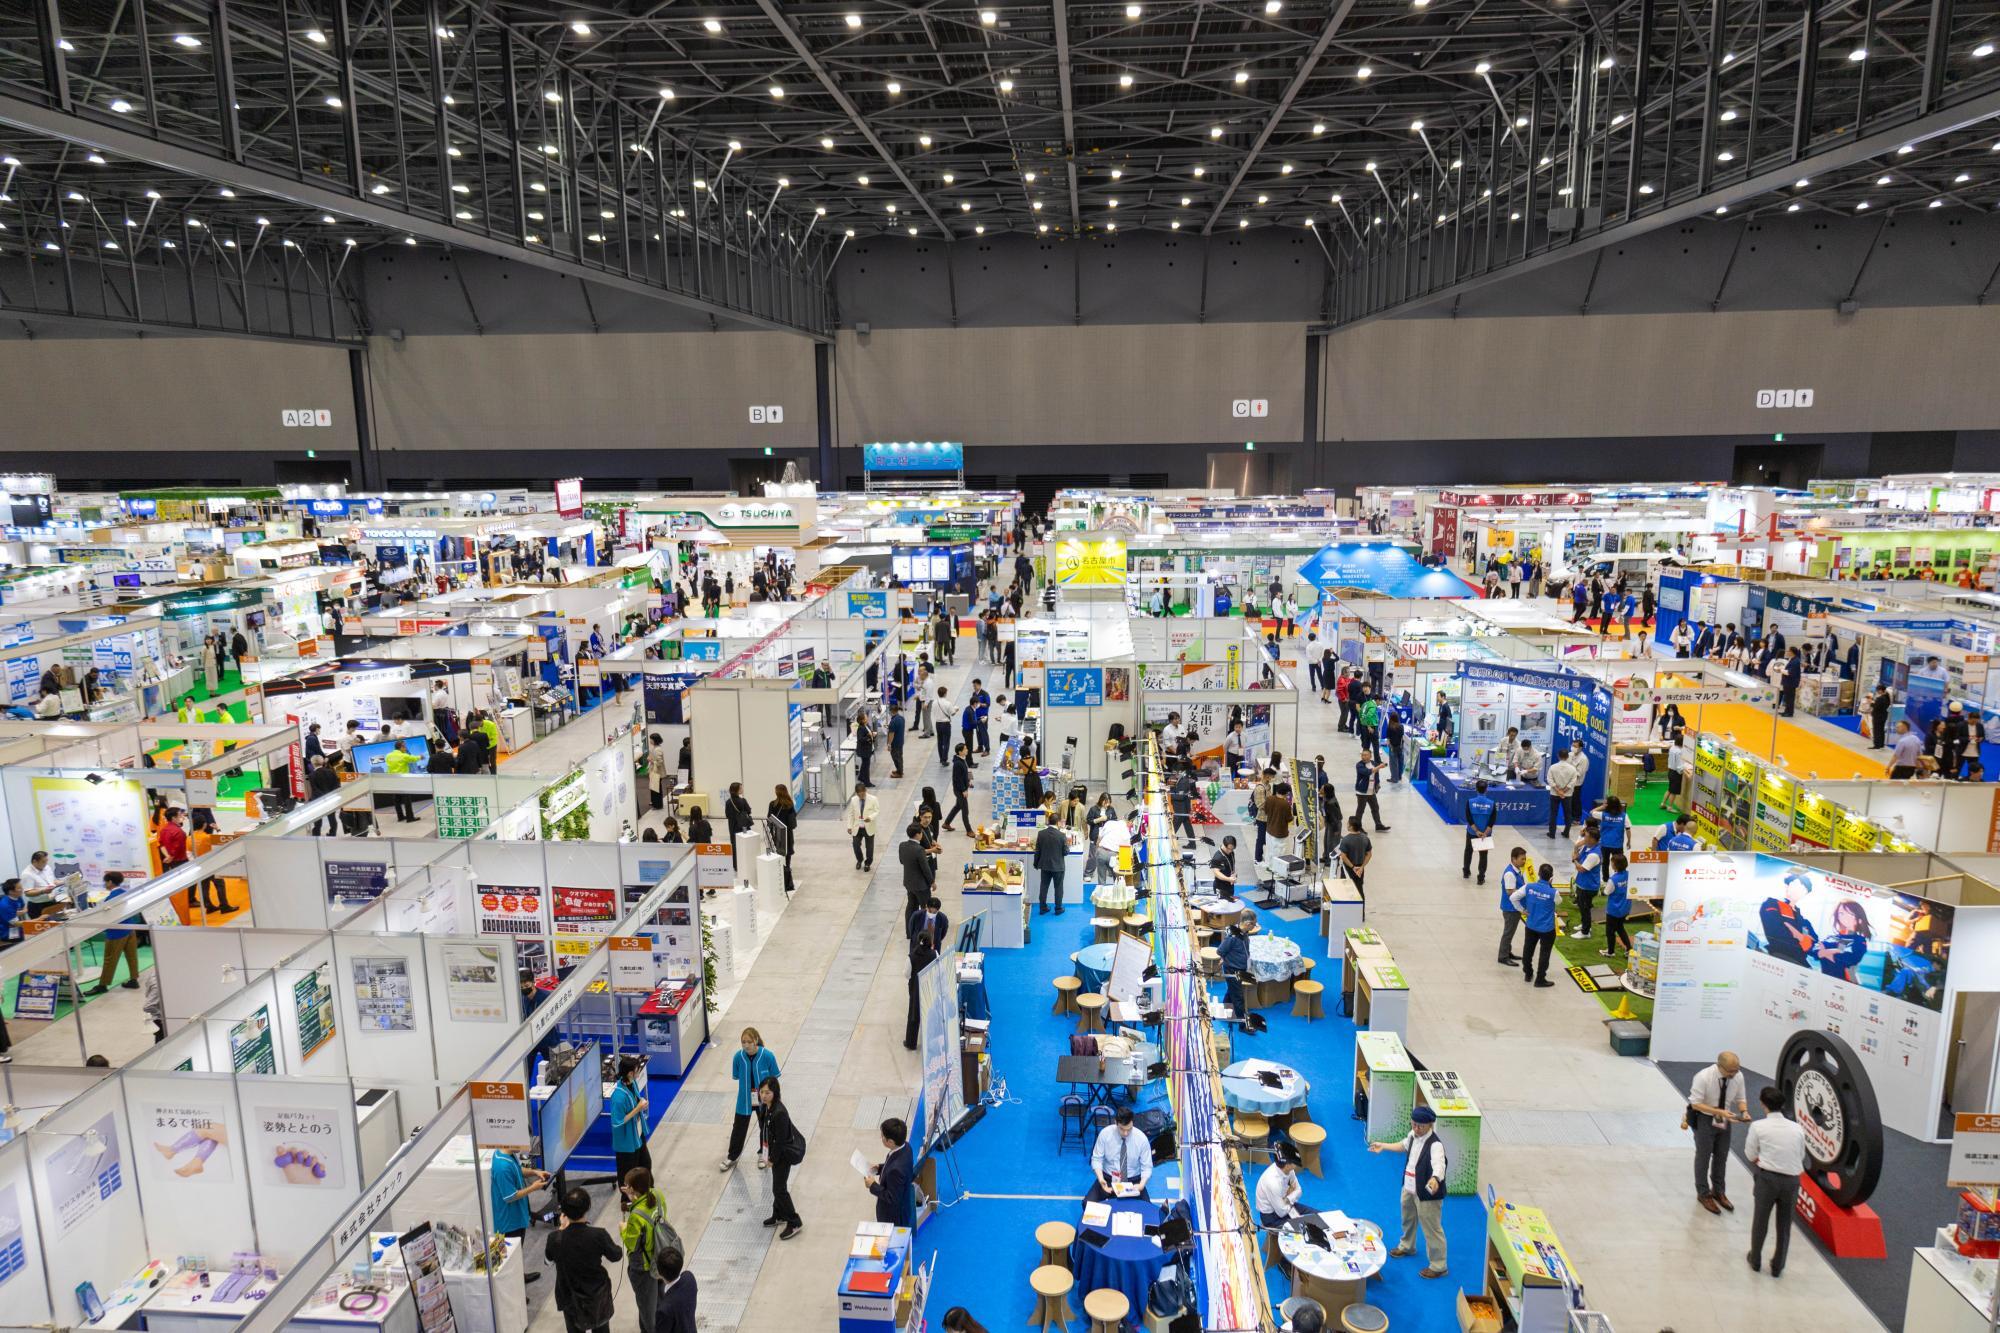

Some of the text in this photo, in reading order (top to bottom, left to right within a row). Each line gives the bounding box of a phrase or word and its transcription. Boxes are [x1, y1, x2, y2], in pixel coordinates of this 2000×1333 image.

[1236, 402, 1247, 415] C
[753, 409, 762, 421] B
[1082, 556, 1116, 565] 名古屋市
[1402, 643, 1428, 656] SUN
[115, 653, 131, 666] K6
[1694, 692, 1719, 700] マルワ
[1200, 677, 1213, 736] 企進出を
[439, 807, 489, 817] 復職支
[706, 845, 722, 853] C-3
[1638, 852, 1660, 860] C-11
[1903, 1055, 1909, 1067] 1
[486, 1085, 508, 1094] C-3
[156, 1117, 214, 1130] まるで指圧
[258, 1122, 328, 1135] 姿勢ととのう
[339, 1171, 404, 1246] 株式会社タナック
